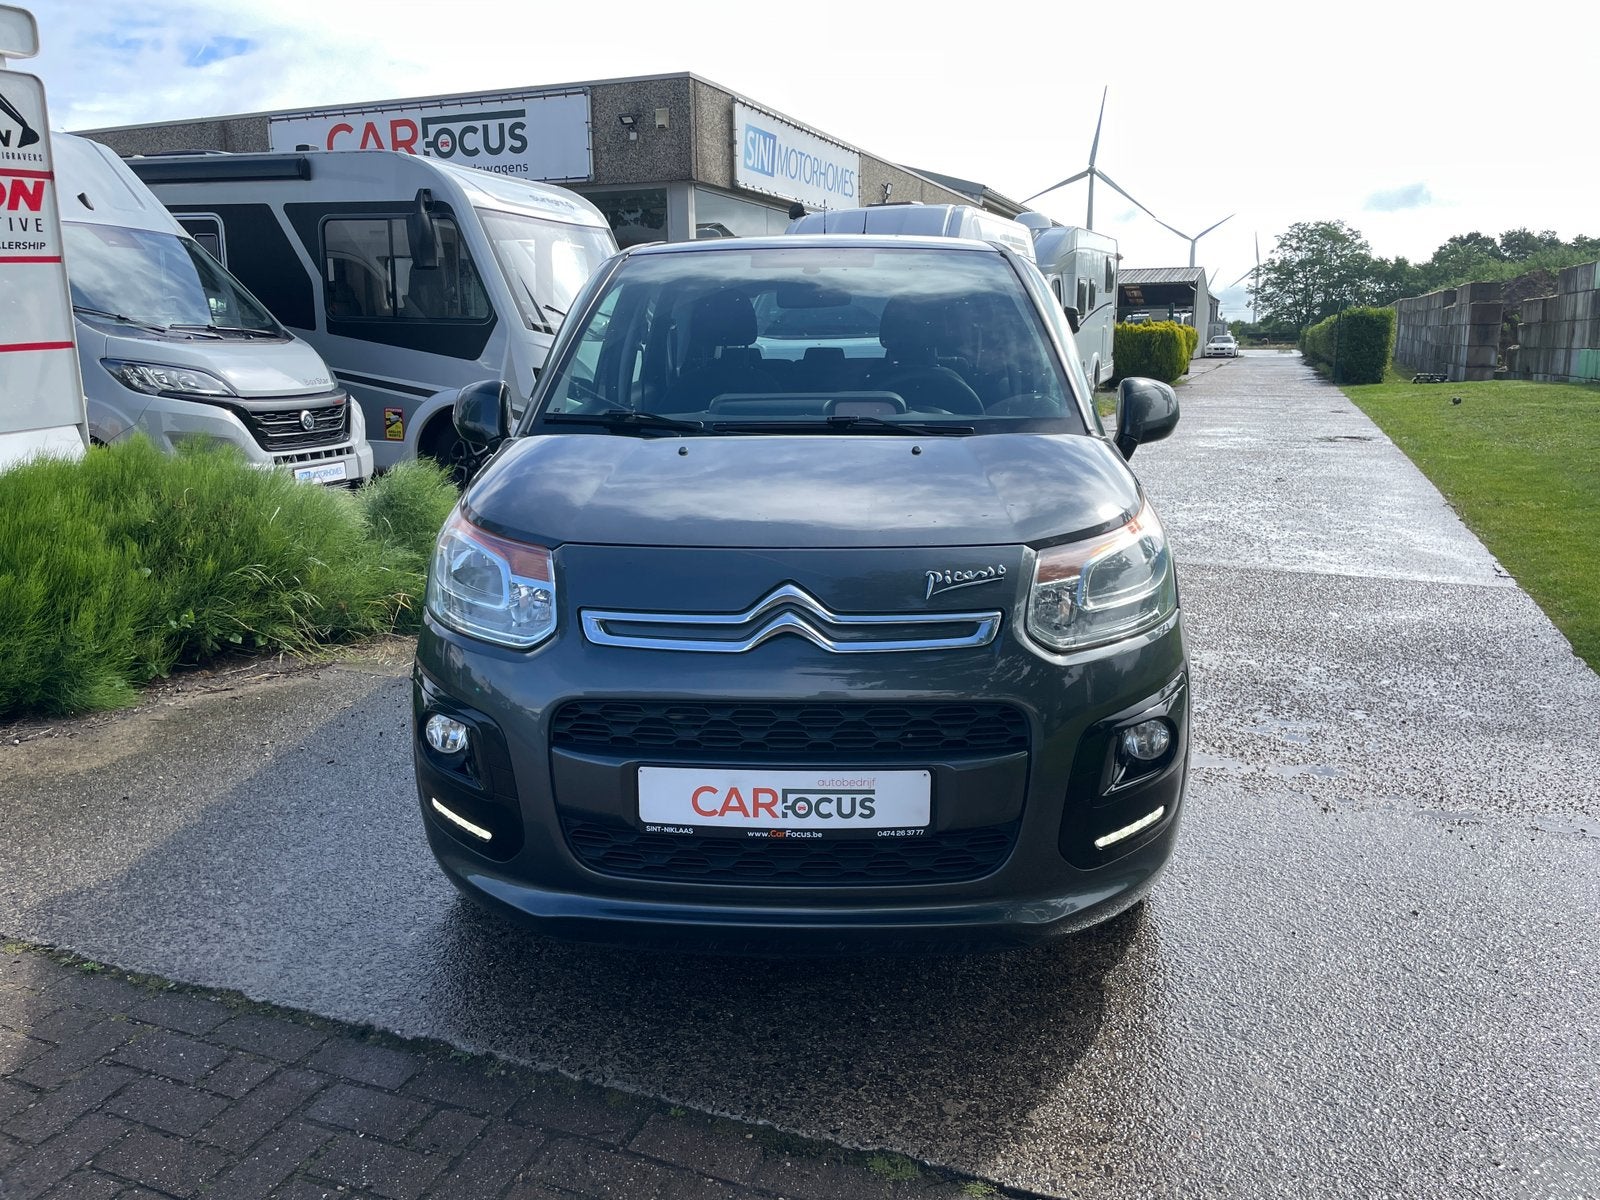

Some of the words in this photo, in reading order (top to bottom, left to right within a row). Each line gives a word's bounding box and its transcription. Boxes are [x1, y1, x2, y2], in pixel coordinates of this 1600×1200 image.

[745, 131, 774, 174] SINI
[776, 144, 855, 198] MOTORHOMES
[0, 179, 45, 211] N
[0, 217, 43, 232] IVE
[0, 241, 46, 250] LERSHIP
[817, 777, 876, 789] autobedrijf
[645, 825, 694, 835] SINT-NIKLAAS
[747, 829, 823, 838] www.CarFocus.be
